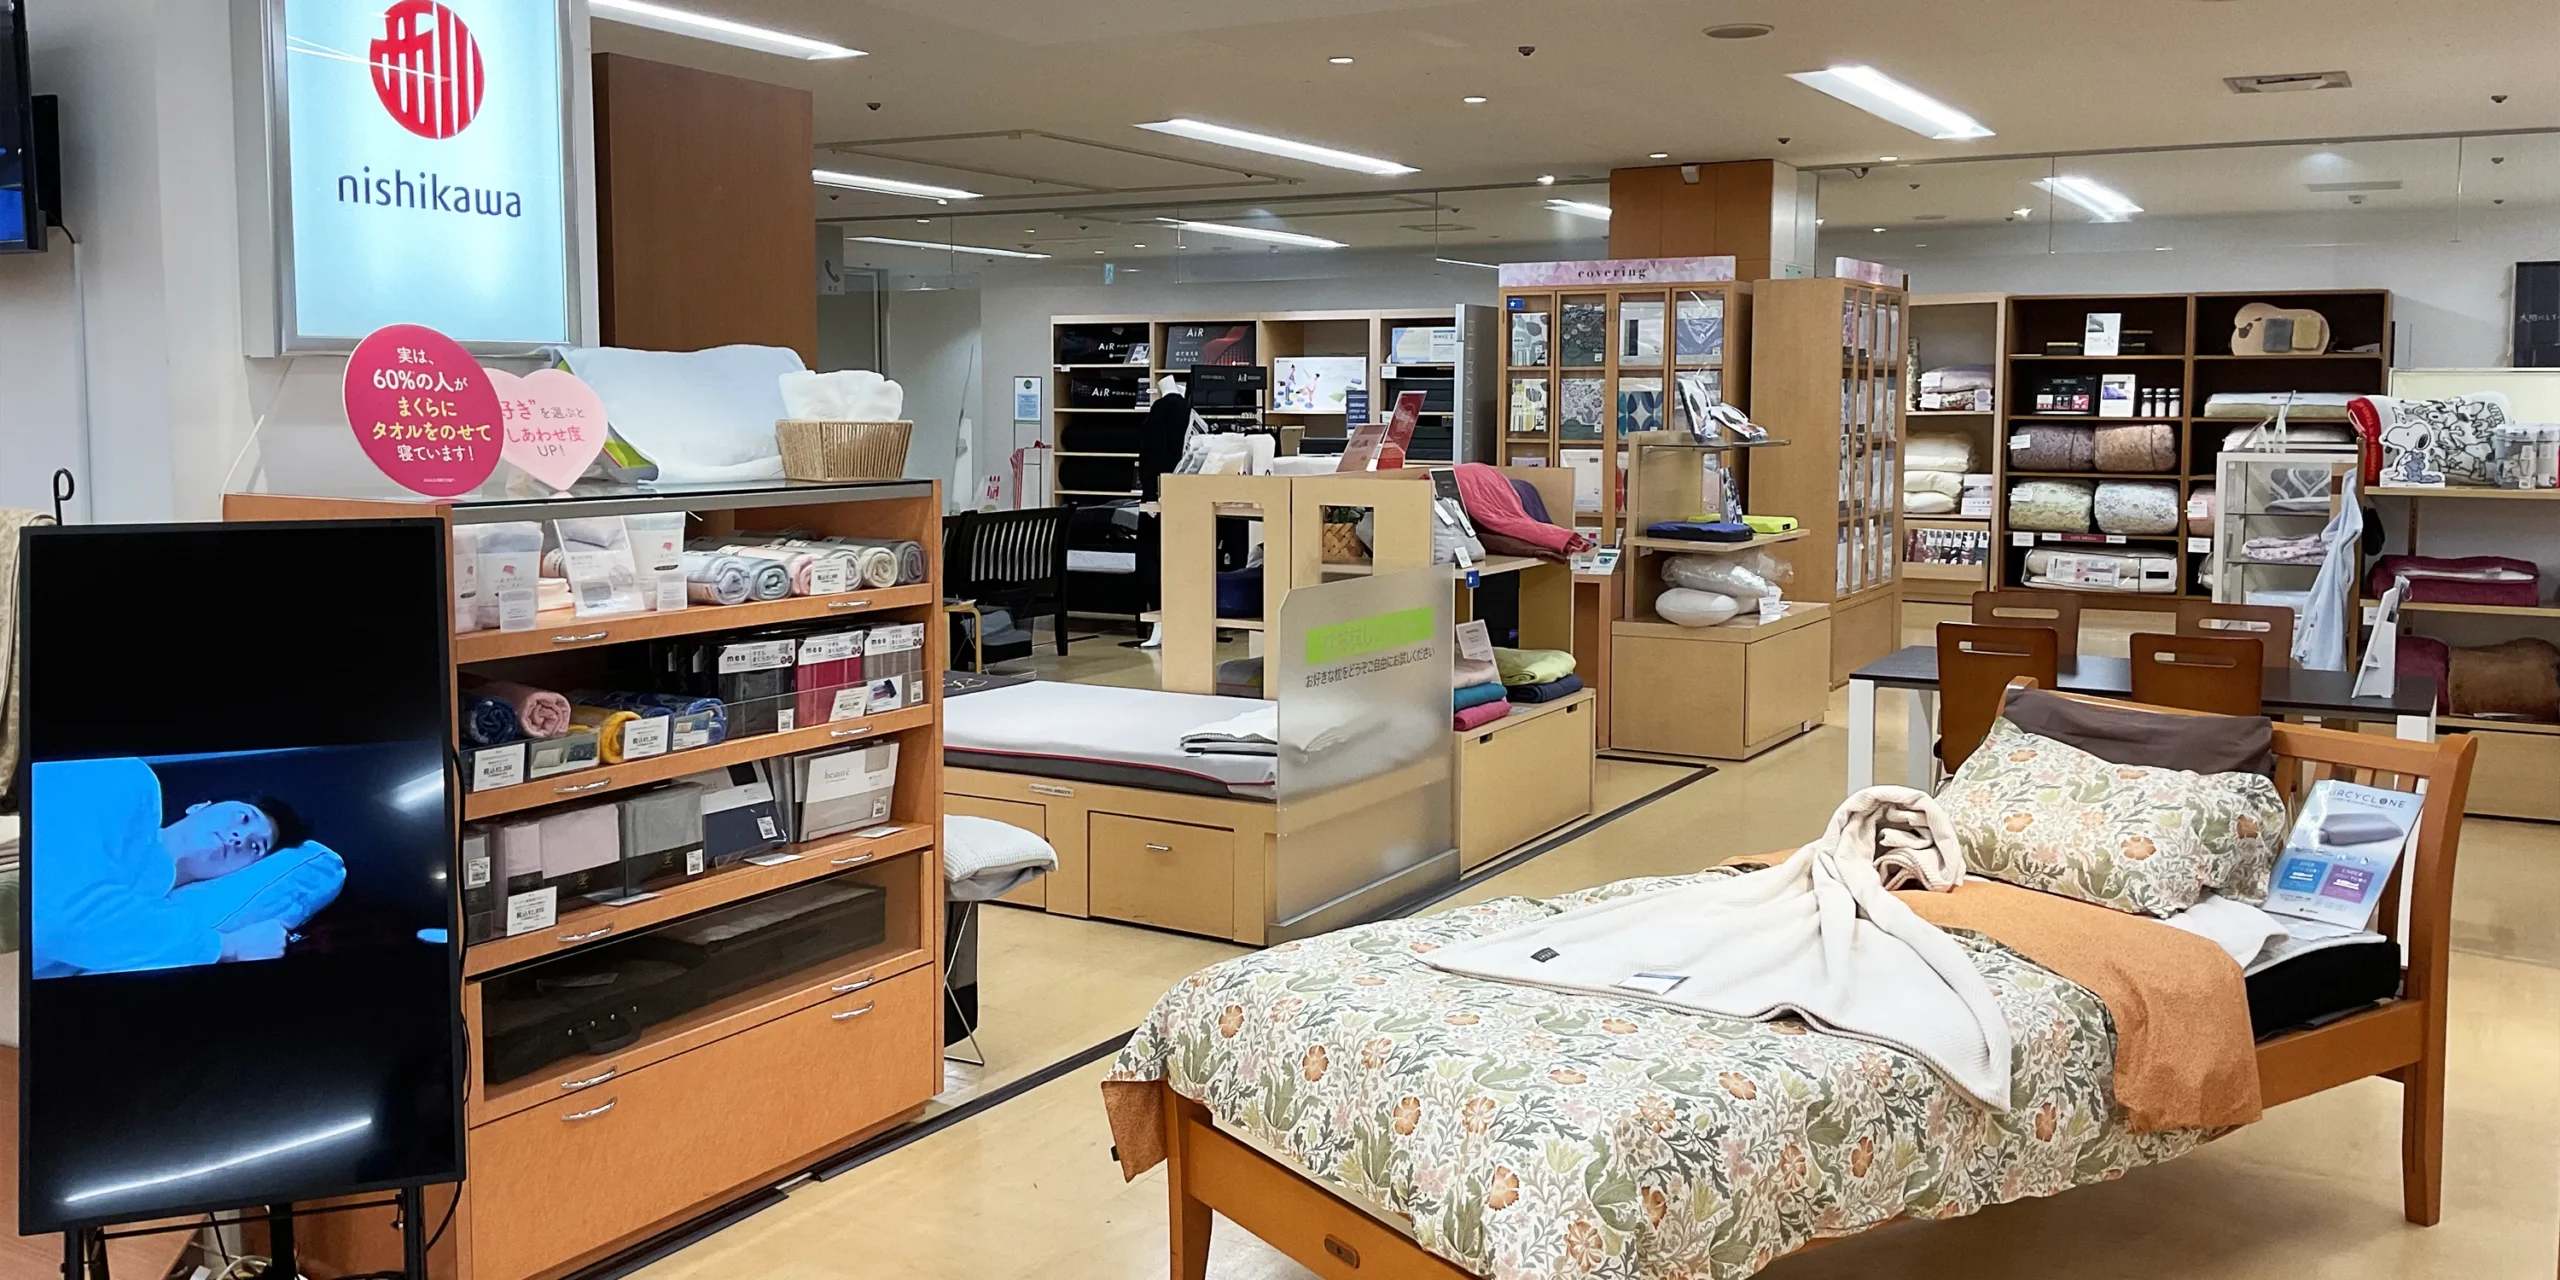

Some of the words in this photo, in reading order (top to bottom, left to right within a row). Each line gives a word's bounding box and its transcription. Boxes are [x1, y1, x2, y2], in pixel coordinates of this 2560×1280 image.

[337, 166, 522, 218] nishikawa
[1578, 265, 1647, 280] covering
[1186, 328, 1204, 337] AiR
[1098, 342, 1115, 350] AiR
[397, 346, 435, 365] 実は、
[1091, 387, 1110, 396] AiR
[398, 396, 458, 417] まくらに
[372, 421, 492, 441] タオルをのせて
[506, 425, 585, 443] しあわせ度
[397, 444, 475, 462] 寝ています!
[536, 444, 565, 457] UP!
[726, 654, 746, 662] mee
